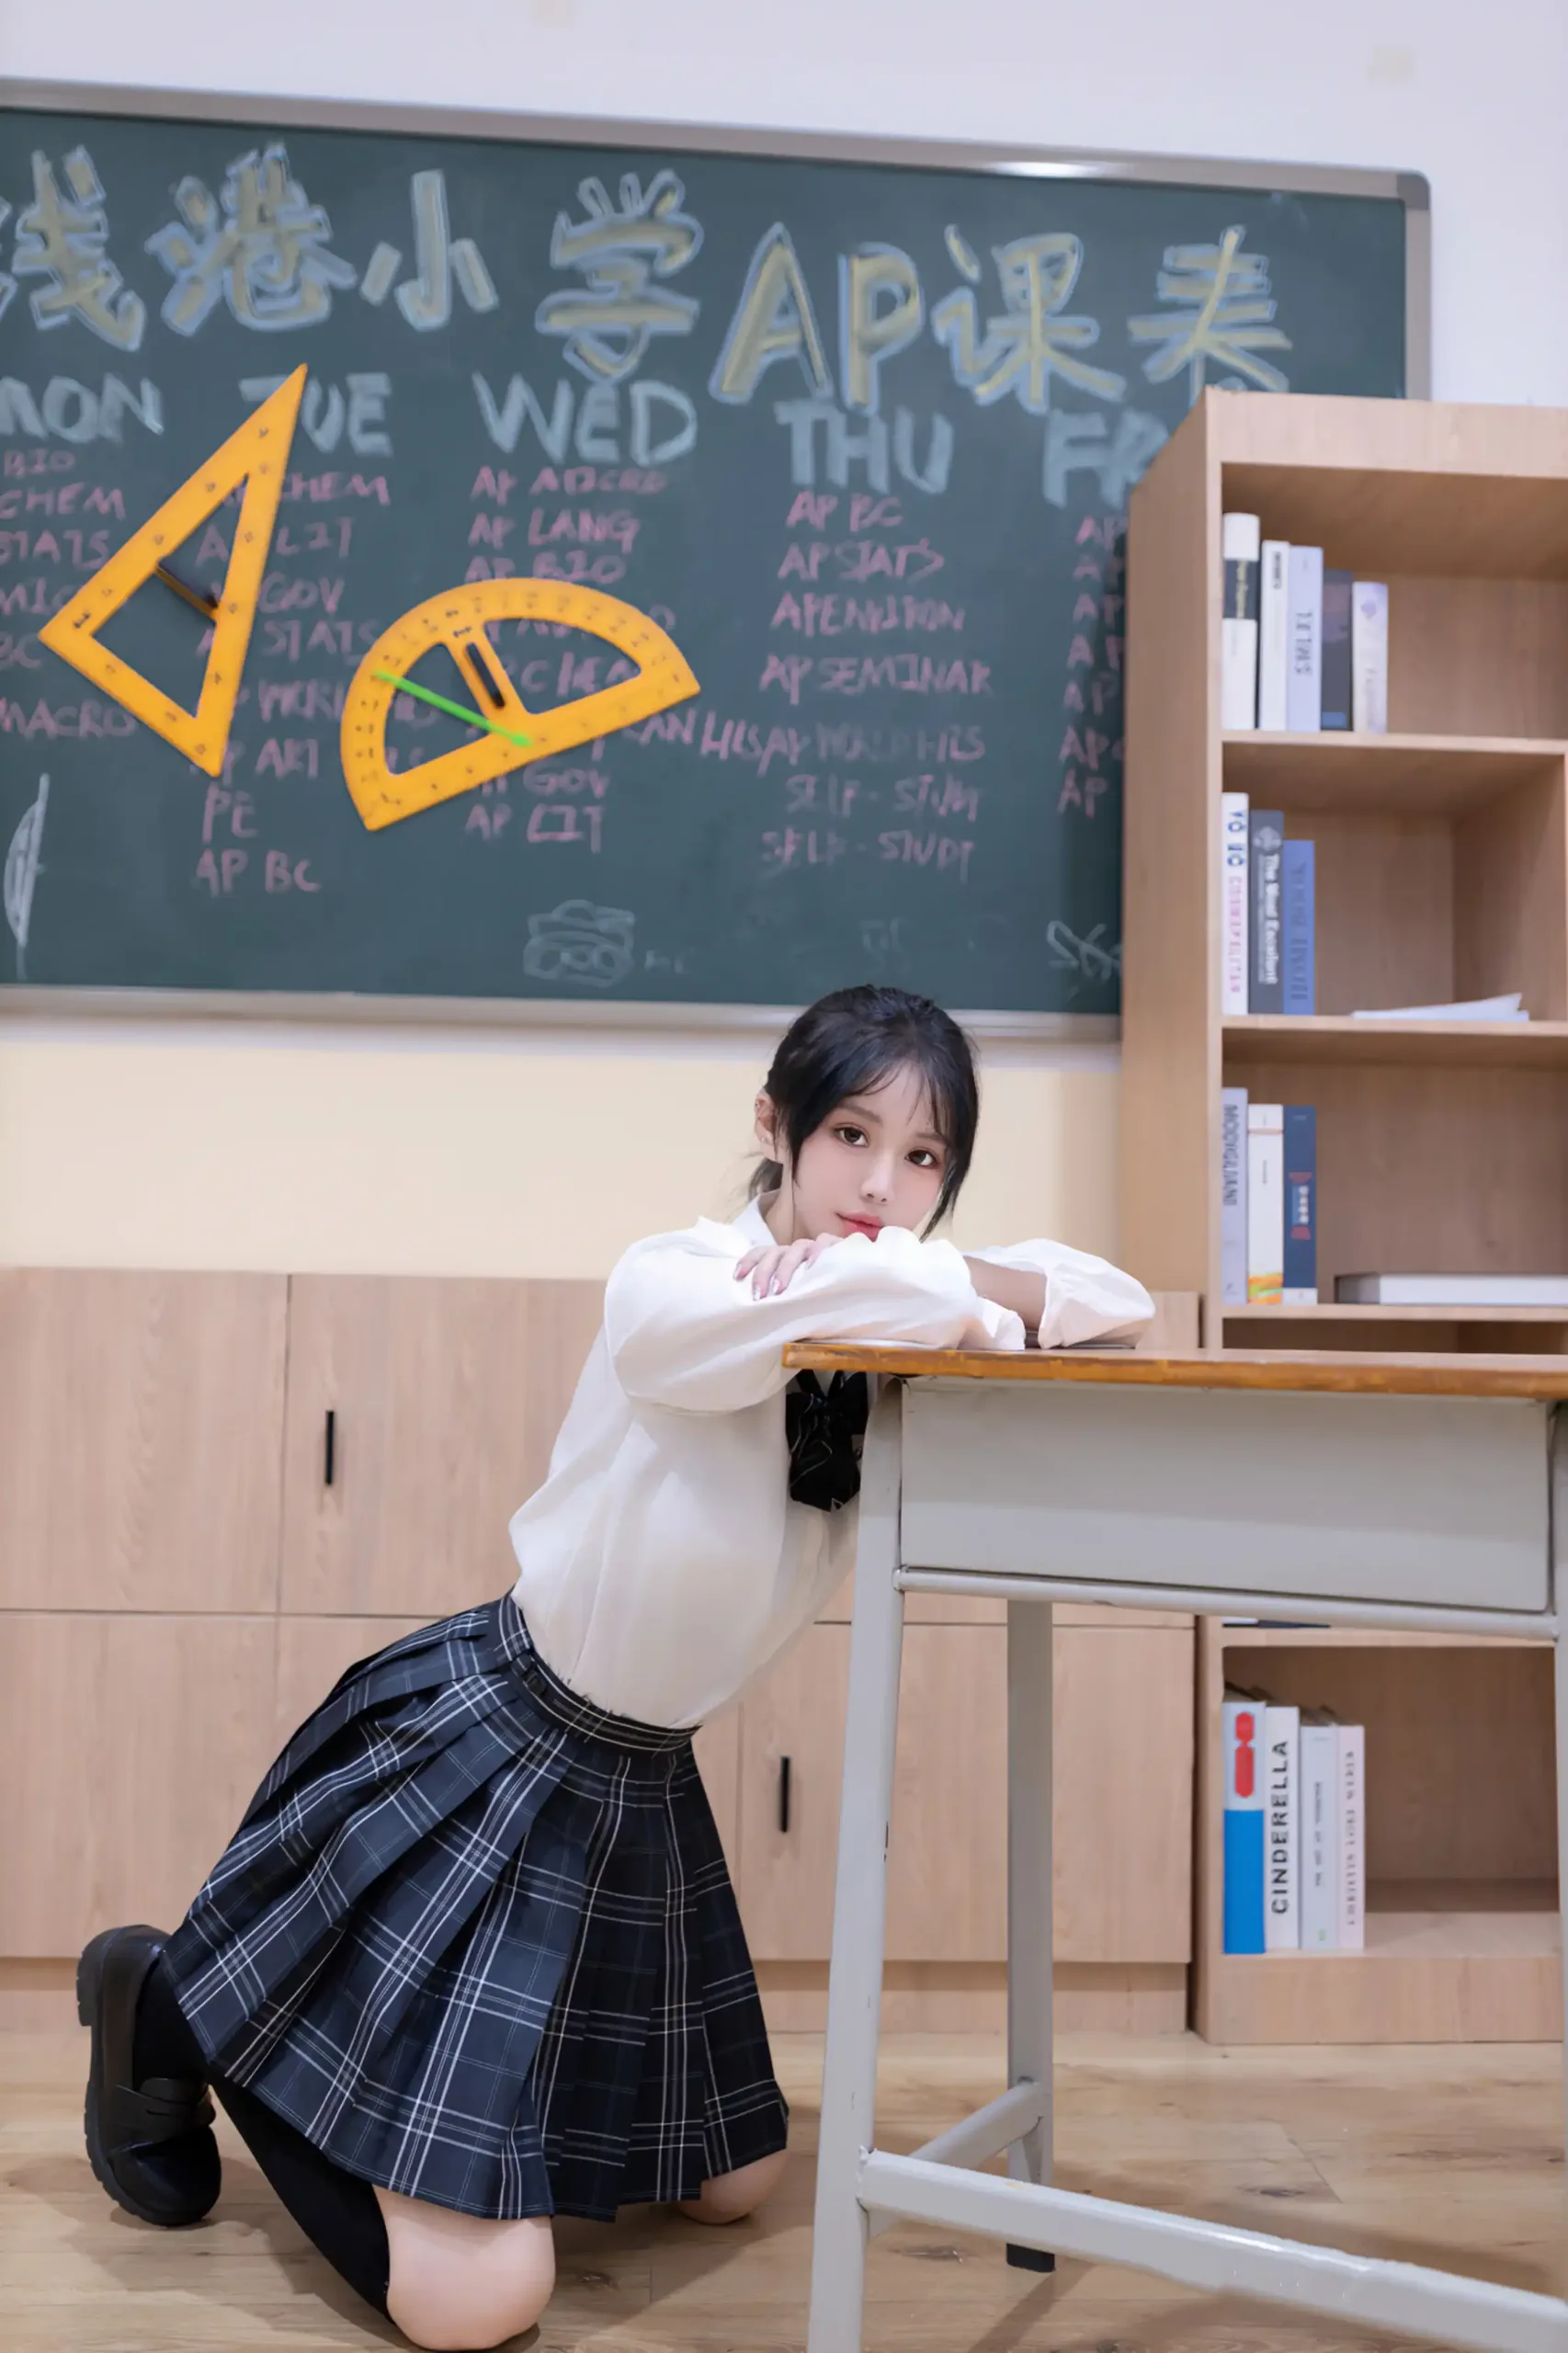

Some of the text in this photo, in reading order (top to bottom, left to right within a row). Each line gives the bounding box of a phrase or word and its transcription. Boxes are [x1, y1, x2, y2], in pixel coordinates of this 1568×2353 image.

[472, 371, 697, 466] WED
[774, 399, 954, 494] THU
[470, 465, 518, 506] AP
[1043, 407, 1169, 509] FR
[468, 507, 642, 554] AP LANG
[786, 490, 838, 530] AP
[202, 781, 259, 845] PE
[465, 802, 513, 840] AP
[195, 848, 322, 899] AP BC
[1271, 1740, 1289, 1915] CINDERELLA
